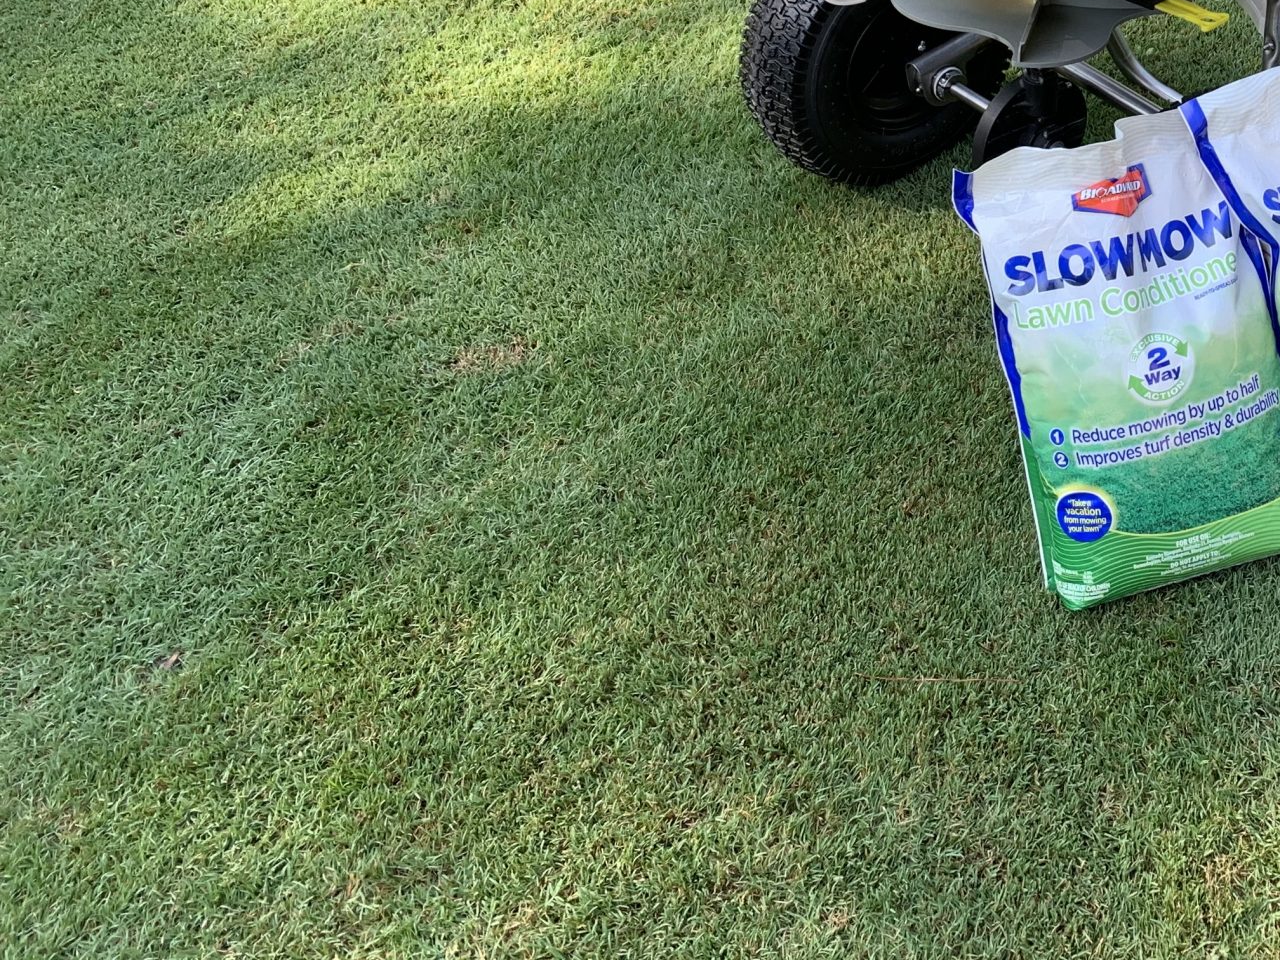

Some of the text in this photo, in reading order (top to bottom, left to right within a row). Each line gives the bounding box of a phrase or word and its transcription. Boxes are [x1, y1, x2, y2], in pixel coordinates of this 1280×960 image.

[1004, 200, 1234, 296] SLOW MOW
[1013, 251, 1237, 329] Lawn Conditione
[1130, 334, 1180, 362] EXCLUSIVE
[1147, 347, 1171, 371] 2
[1144, 366, 1181, 385] Way
[1144, 380, 1185, 400] ACTION
[1052, 374, 1260, 444] 1 Reduce mowing by up to half
[1056, 389, 1280, 467] 2 Improves turf density & durability
[1063, 515, 1079, 523] from
[1064, 507, 1102, 516] vacation
[1068, 525, 1082, 533] your
